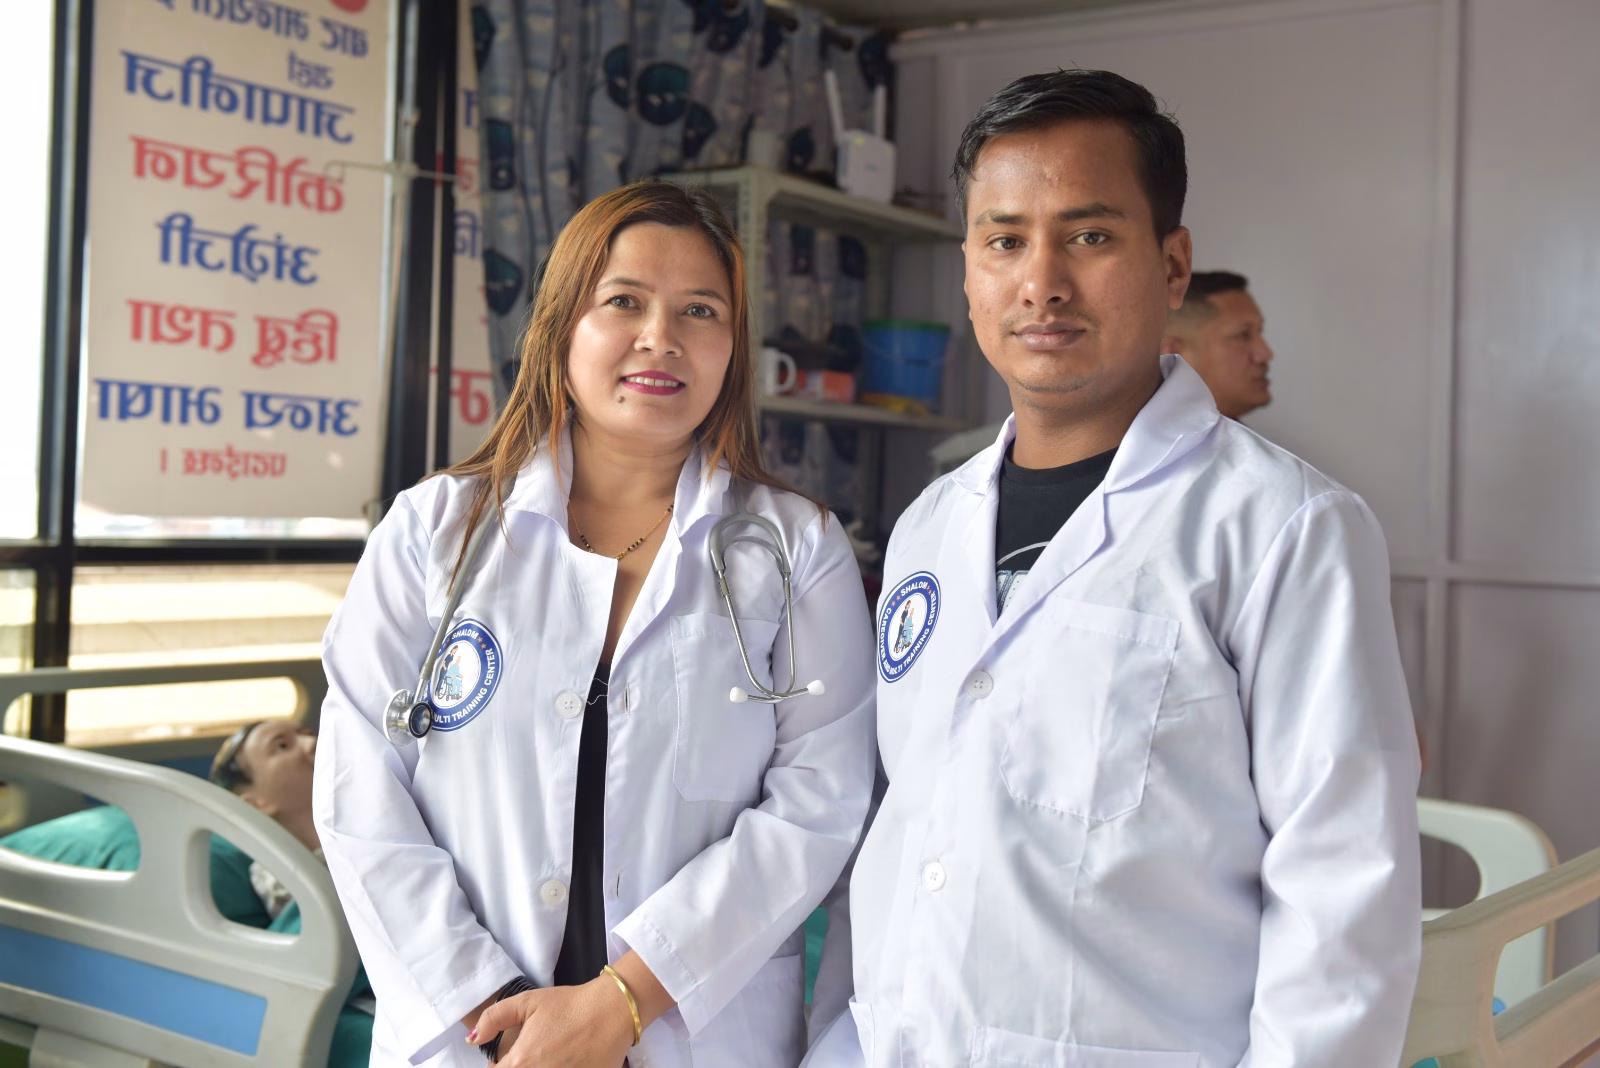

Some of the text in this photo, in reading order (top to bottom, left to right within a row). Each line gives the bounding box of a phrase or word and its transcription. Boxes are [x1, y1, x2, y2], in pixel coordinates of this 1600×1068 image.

[900, 581, 927, 597] SHALOM
[451, 628, 479, 640] SHALOM
[879, 608, 892, 661] CAREGIVER
[902, 627, 929, 668] TRAINING
[927, 590, 936, 626] CENTER
[433, 647, 496, 724] ULTI TRAINING CENTER
